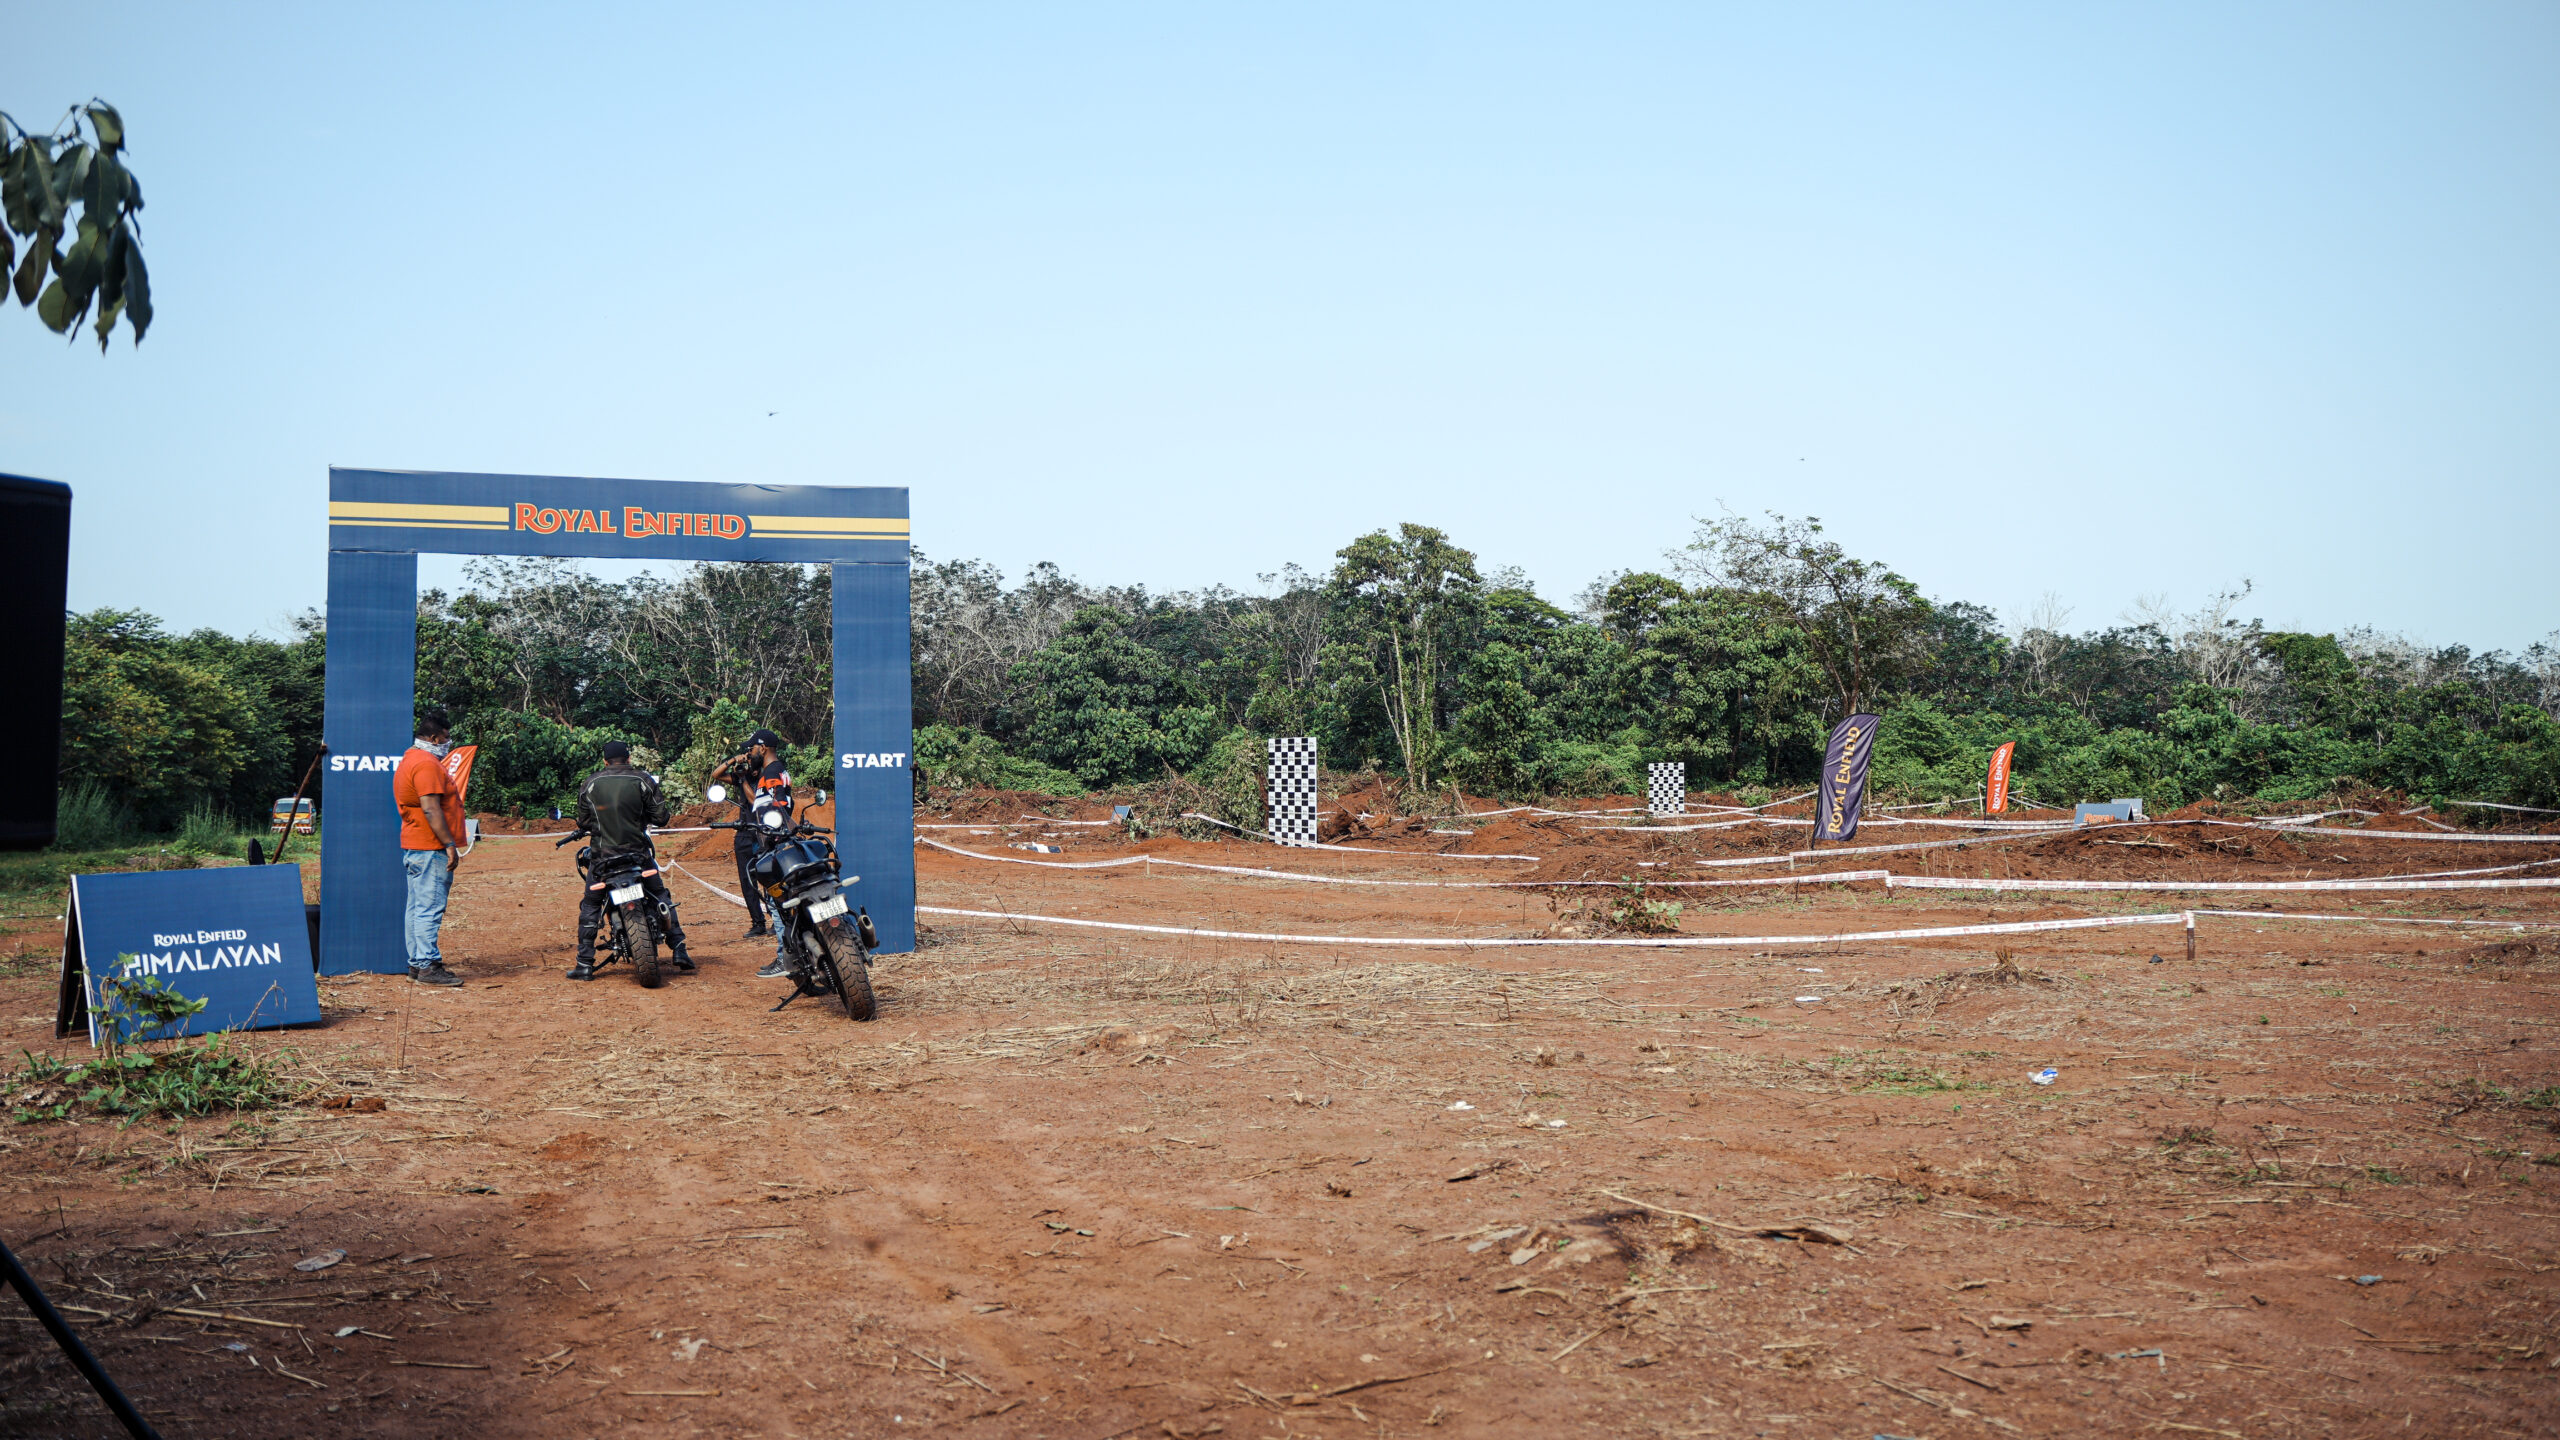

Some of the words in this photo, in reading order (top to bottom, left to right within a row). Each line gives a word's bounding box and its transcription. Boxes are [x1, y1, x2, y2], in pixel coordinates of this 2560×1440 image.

[515, 503, 617, 534] ROYAL
[624, 506, 746, 540] ENFIELD
[330, 755, 403, 772] START
[841, 752, 906, 769] START
[1835, 726, 1861, 784] ENFIELD
[1827, 787, 1847, 834] ROYAL
[1992, 782, 2002, 810] ROYAL
[153, 933, 196, 947] ROYAL
[197, 929, 248, 945] ENFIELD
[124, 942, 282, 977] HIMALAYAN
